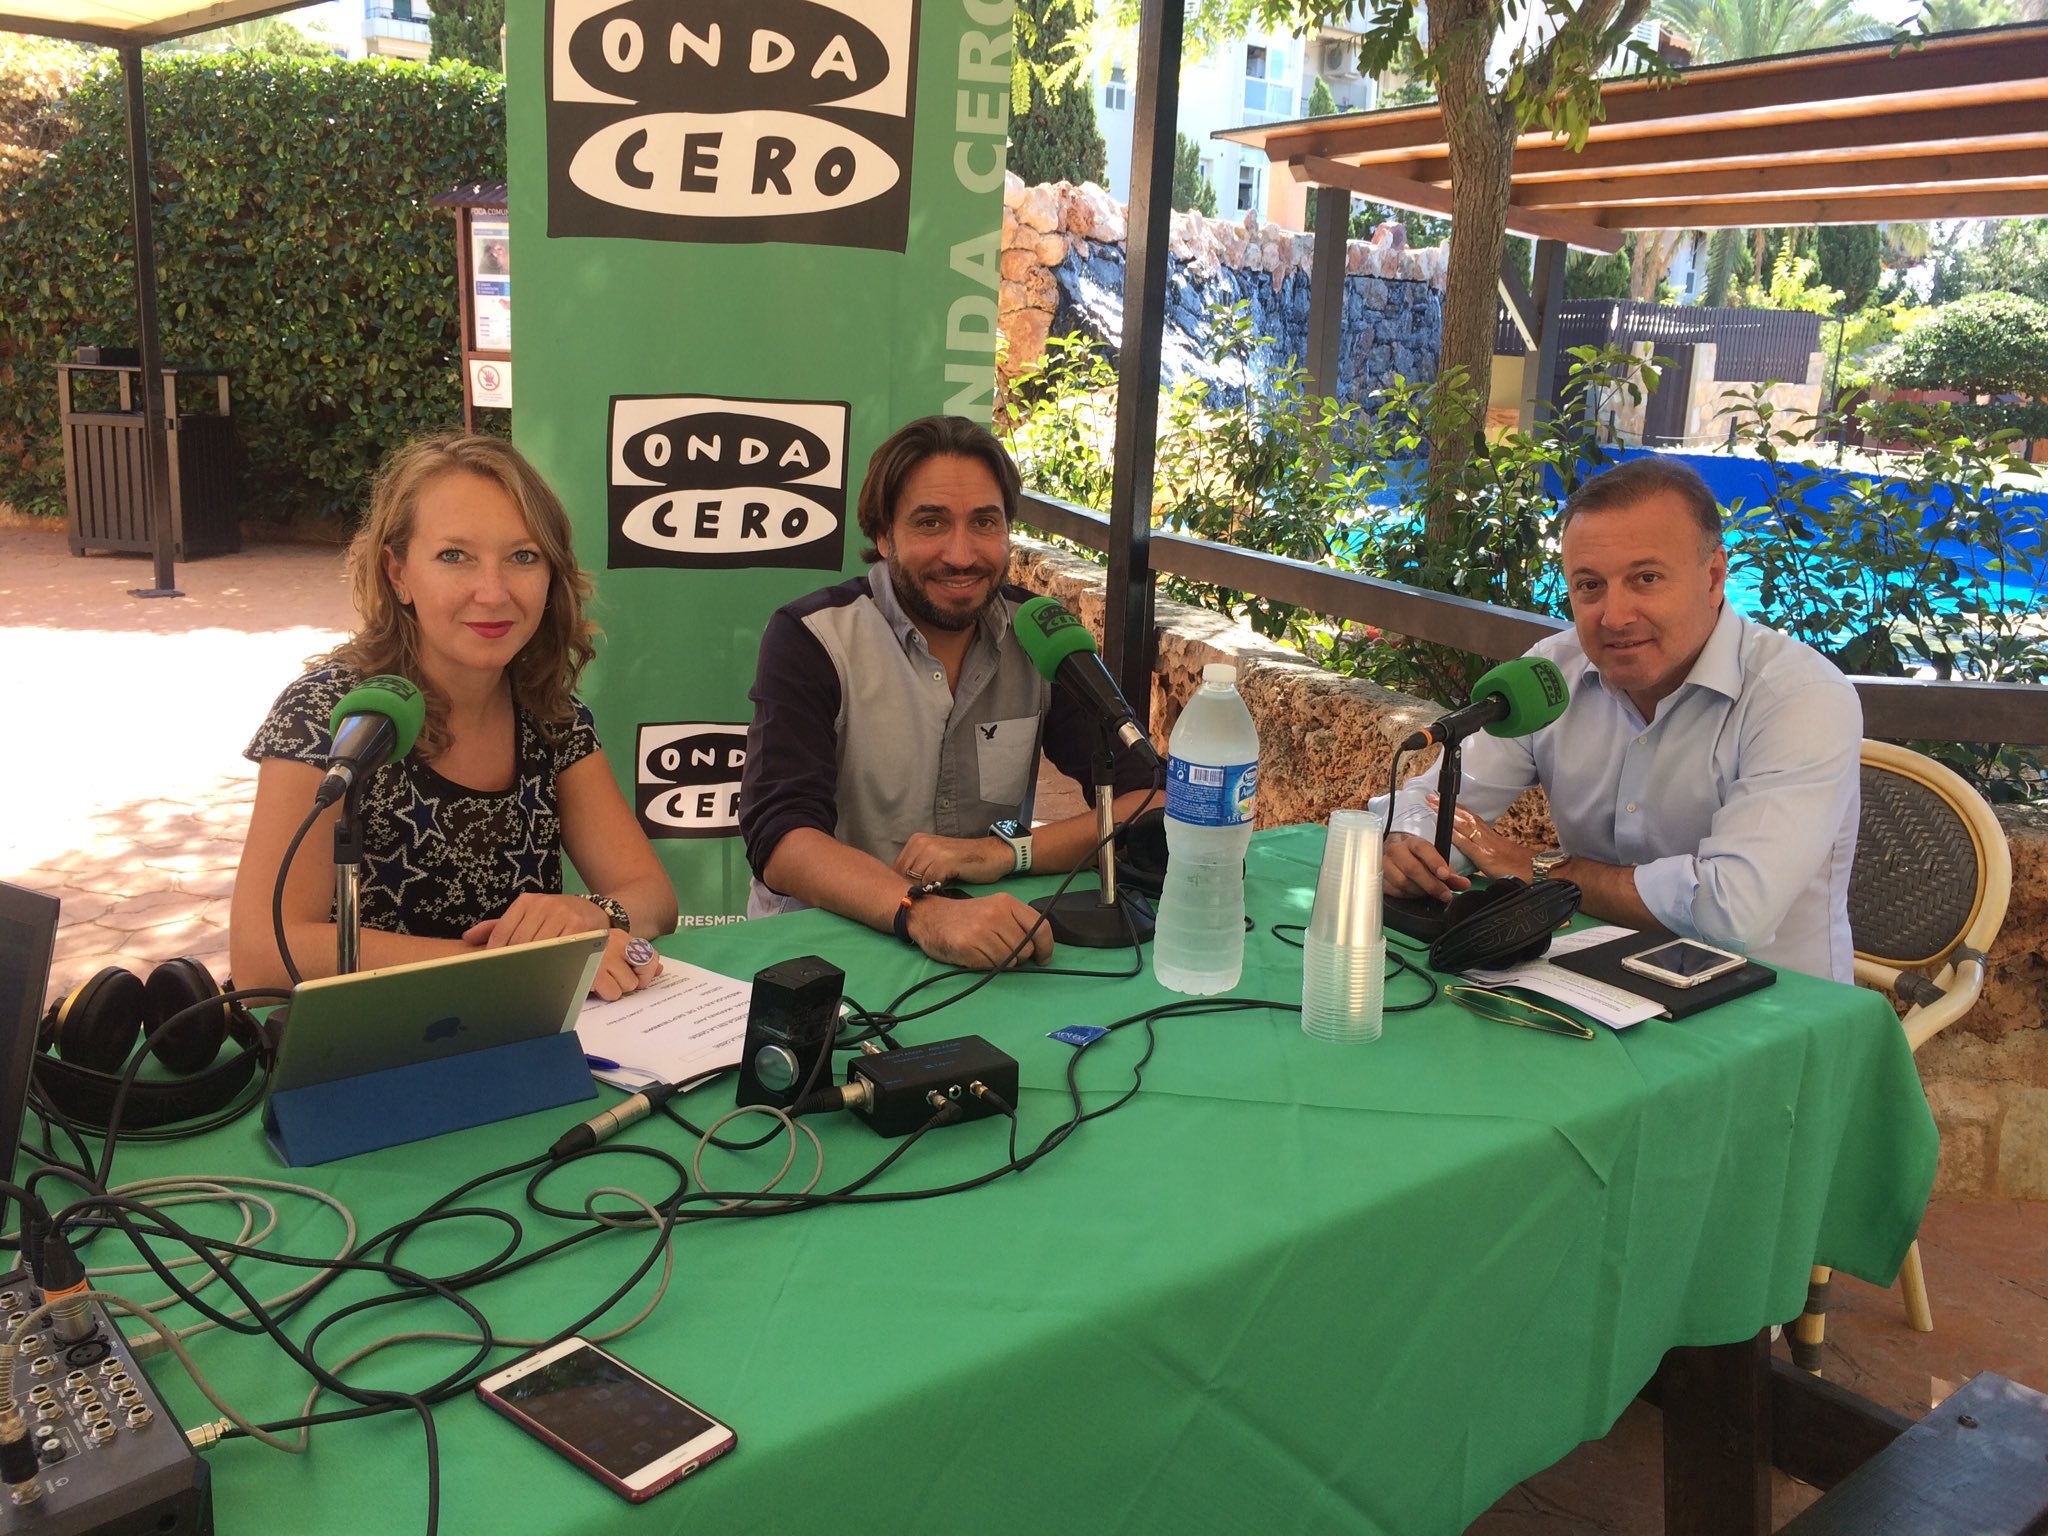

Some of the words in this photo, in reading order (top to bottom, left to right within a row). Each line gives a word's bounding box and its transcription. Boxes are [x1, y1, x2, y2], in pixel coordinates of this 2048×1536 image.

[602, 18, 858, 82] ONDA
[615, 128, 857, 197] CERO
[943, 229, 1003, 424] NDA
[643, 433, 810, 468] ONDA
[652, 500, 809, 539] CERO
[660, 748, 747, 771] OND
[666, 792, 741, 818] CER
[677, 915, 747, 927] TRESMED
